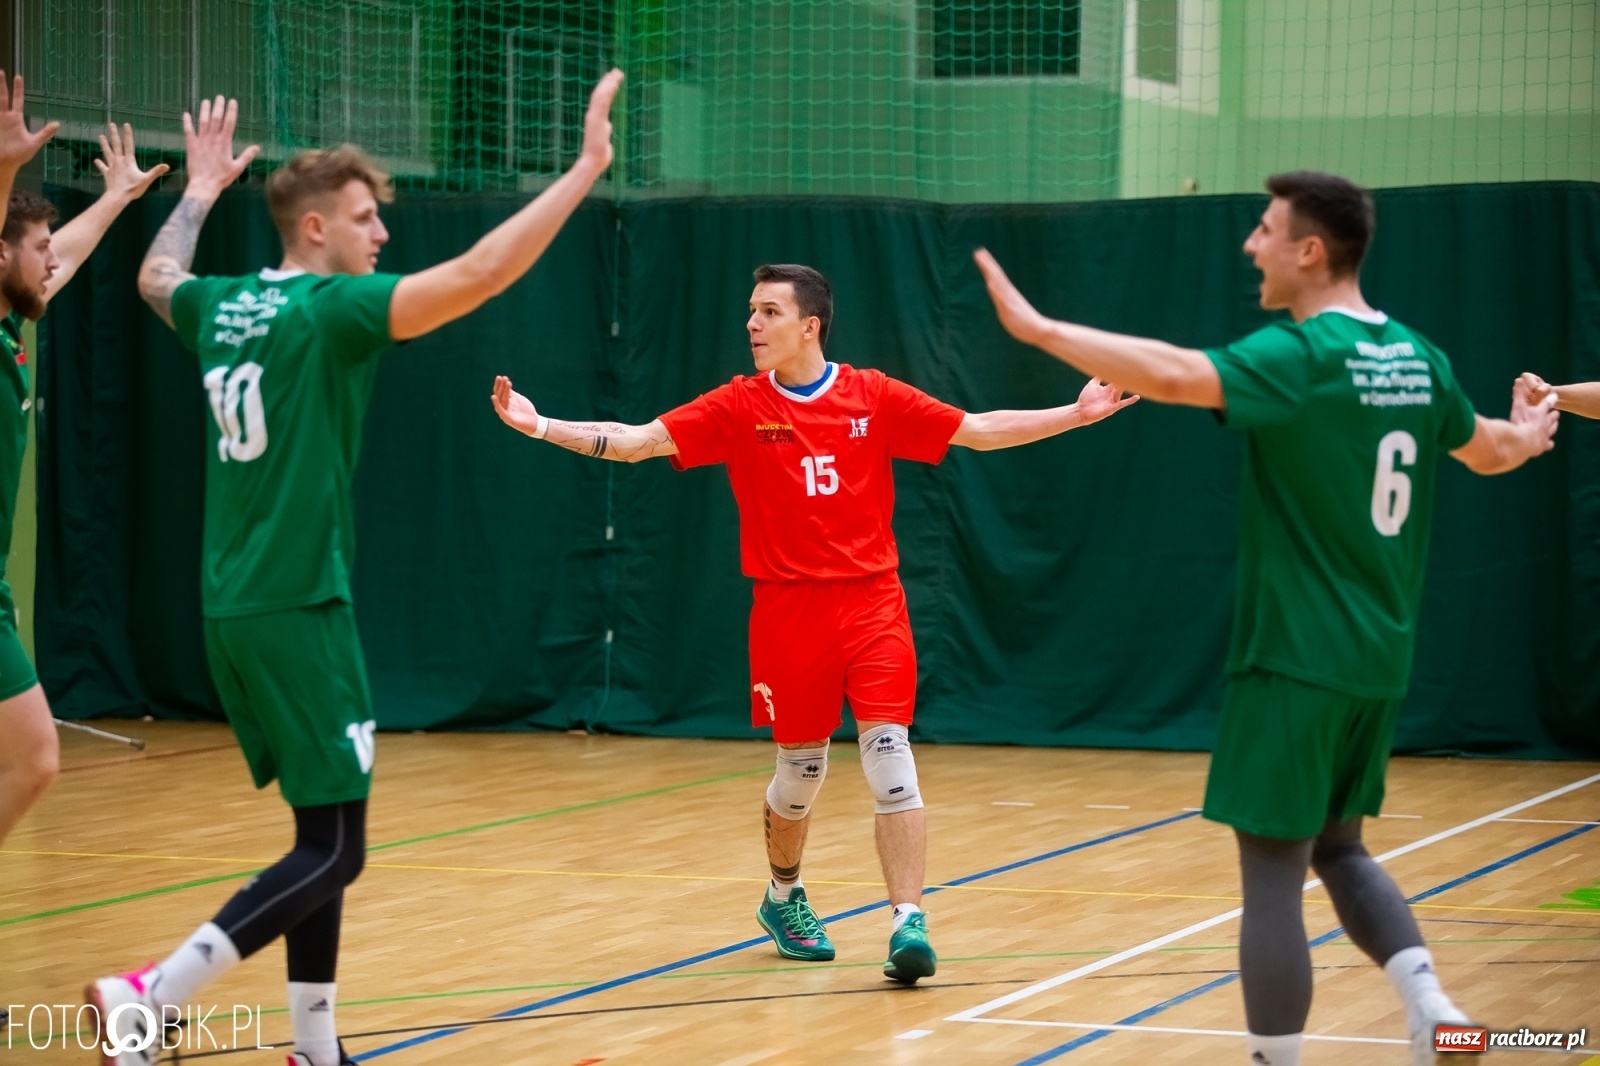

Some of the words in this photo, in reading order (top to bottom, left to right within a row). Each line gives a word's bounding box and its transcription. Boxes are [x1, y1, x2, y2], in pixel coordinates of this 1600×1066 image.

[203, 361, 268, 462] 10
[800, 455, 839, 496] 15
[1371, 430, 1417, 536] 6
